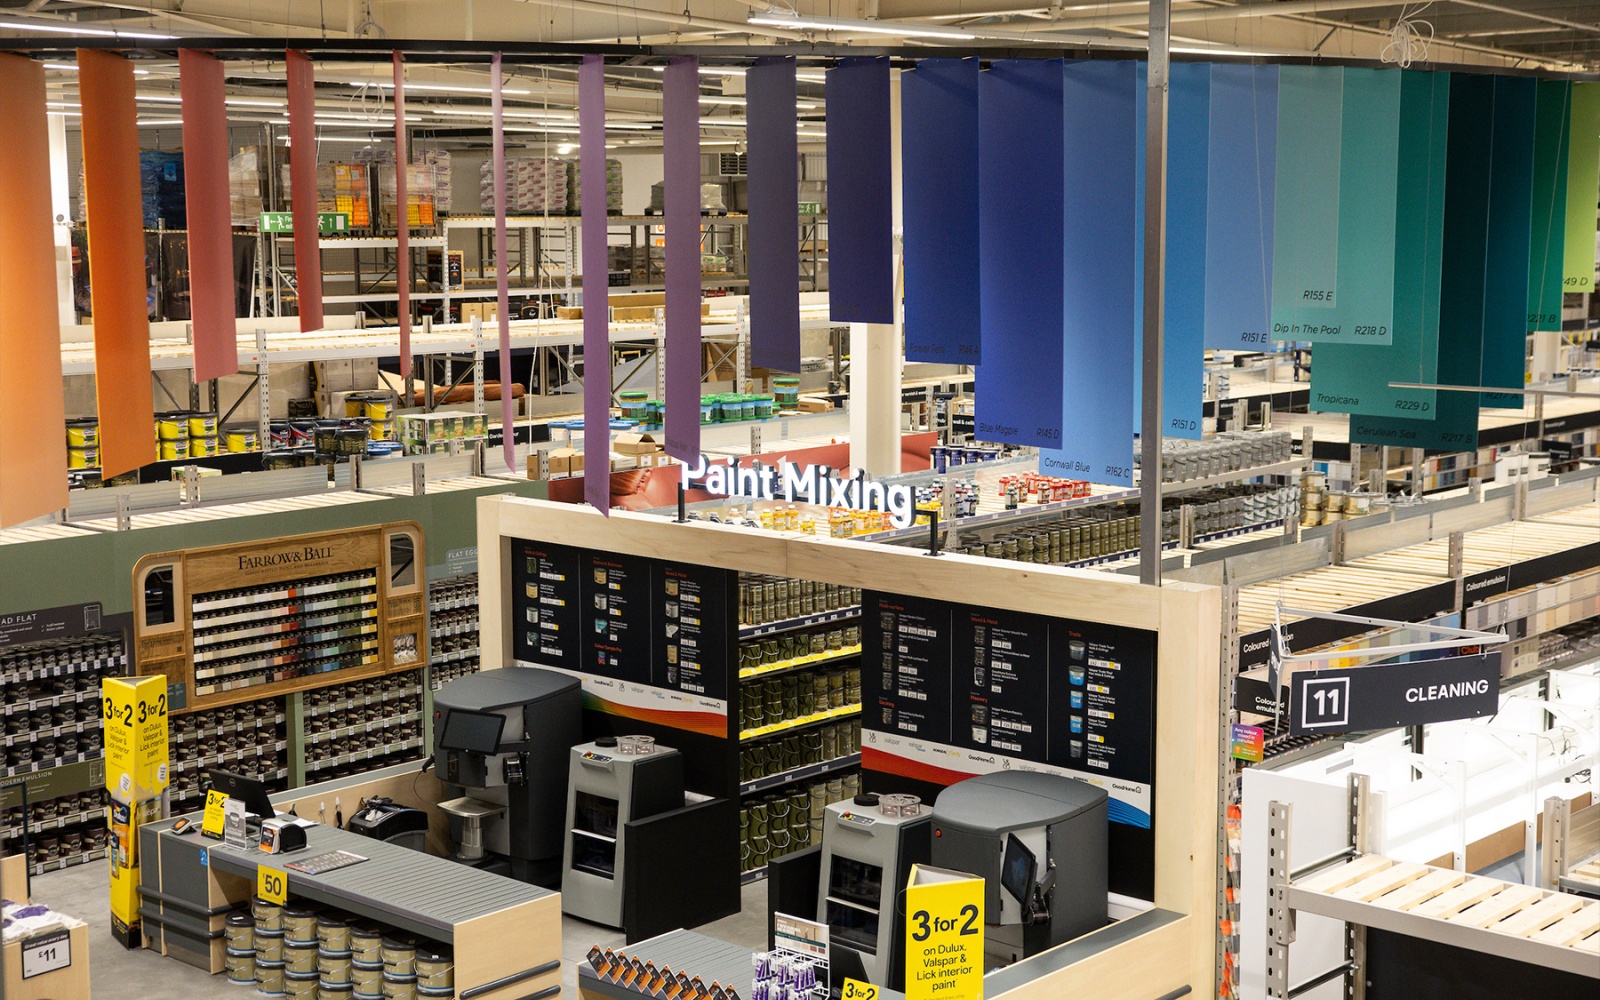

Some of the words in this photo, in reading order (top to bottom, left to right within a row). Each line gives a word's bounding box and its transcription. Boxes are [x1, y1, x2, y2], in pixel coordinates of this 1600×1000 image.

[1580, 278, 1588, 286] D
[1303, 290, 1324, 300] R155
[1326, 291, 1333, 301] E
[1548, 314, 1556, 323] B
[1274, 323, 1289, 333] Dip
[1291, 324, 1300, 333] In
[1302, 324, 1318, 334] The
[1320, 325, 1342, 335] Pool
[1354, 326, 1377, 335] R218
[1379, 326, 1387, 336] D
[1241, 332, 1259, 342] R151
[1260, 333, 1267, 343] E
[1317, 393, 1359, 405] Tropicana
[1395, 400, 1420, 411] R229
[1421, 402, 1429, 411] D
[979, 422, 994, 433] Blue
[994, 424, 1018, 436] Magpie
[1053, 429, 1060, 439] D
[1172, 419, 1188, 430] R151
[1190, 420, 1196, 431] D
[1357, 426, 1397, 438] Cerulean
[1399, 429, 1416, 439] Sea
[1442, 433, 1463, 442] R217
[1465, 434, 1473, 443] B
[1044, 458, 1074, 470] Cornwall
[1074, 461, 1090, 473] Blue
[1106, 466, 1123, 477] R162
[1123, 468, 1130, 479] C
[682, 455, 775, 500] Paint
[785, 461, 913, 528] Mixing
[238, 552, 293, 570] FARROW
[303, 547, 334, 561] BALL
[448, 551, 463, 559] FLAT
[16, 613, 37, 623] FLAT
[1243, 639, 1269, 653] Coloured
[1405, 679, 1489, 703] CLEANING
[138, 700, 147, 724] 3
[148, 704, 158, 716] for
[158, 694, 166, 717] 2
[1255, 697, 1285, 708] Colourd
[1313, 688, 1339, 716] 11
[105, 697, 113, 720] 3
[114, 706, 123, 719] for
[124, 704, 133, 727] 2
[22, 772, 53, 782] EMULSION
[1112, 783, 1136, 793] GoodHome
[208, 793, 214, 805] 3
[912, 910, 931, 942] 3
[934, 917, 958, 933] for
[960, 904, 979, 936] 2
[38, 947, 56, 962] £11
[923, 948, 936, 956] on
[923, 956, 958, 968] Valspar
[960, 954, 967, 963] &
[916, 970, 937, 981] Lick
[938, 966, 973, 978] interior
[845, 982, 855, 998] 3
[855, 989, 866, 998] for
[866, 988, 875, 1000] 2
[932, 979, 956, 992] paint
